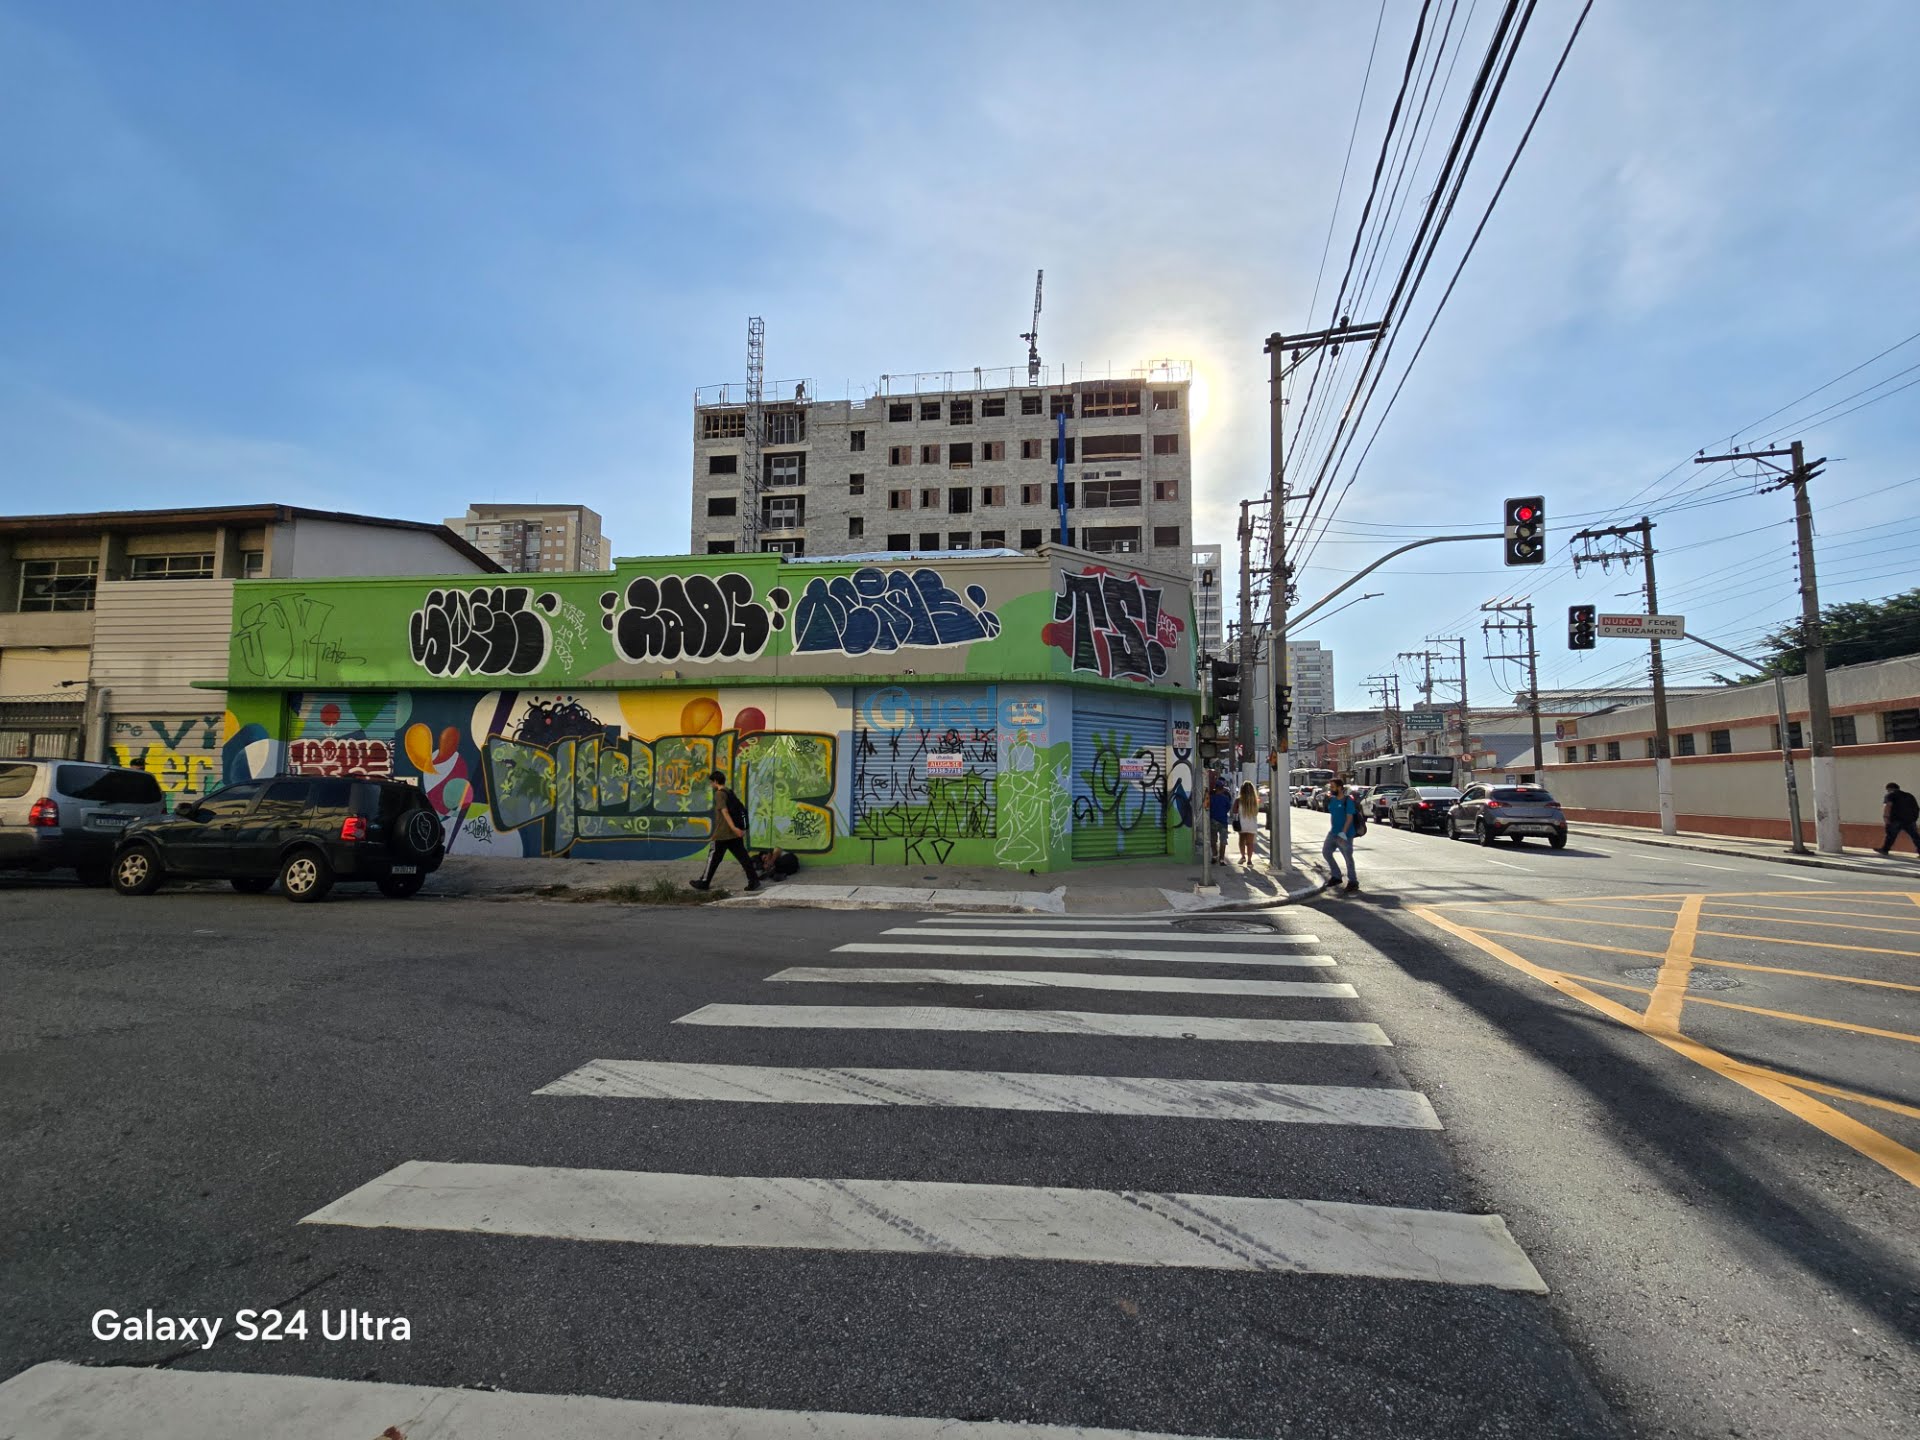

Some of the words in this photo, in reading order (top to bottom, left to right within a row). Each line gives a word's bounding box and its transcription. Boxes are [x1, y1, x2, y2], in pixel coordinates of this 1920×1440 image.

[1648, 619, 1678, 627] FECHE
[1616, 627, 1678, 635] CRUZAMENTO
[1173, 720, 1190, 729] 1019
